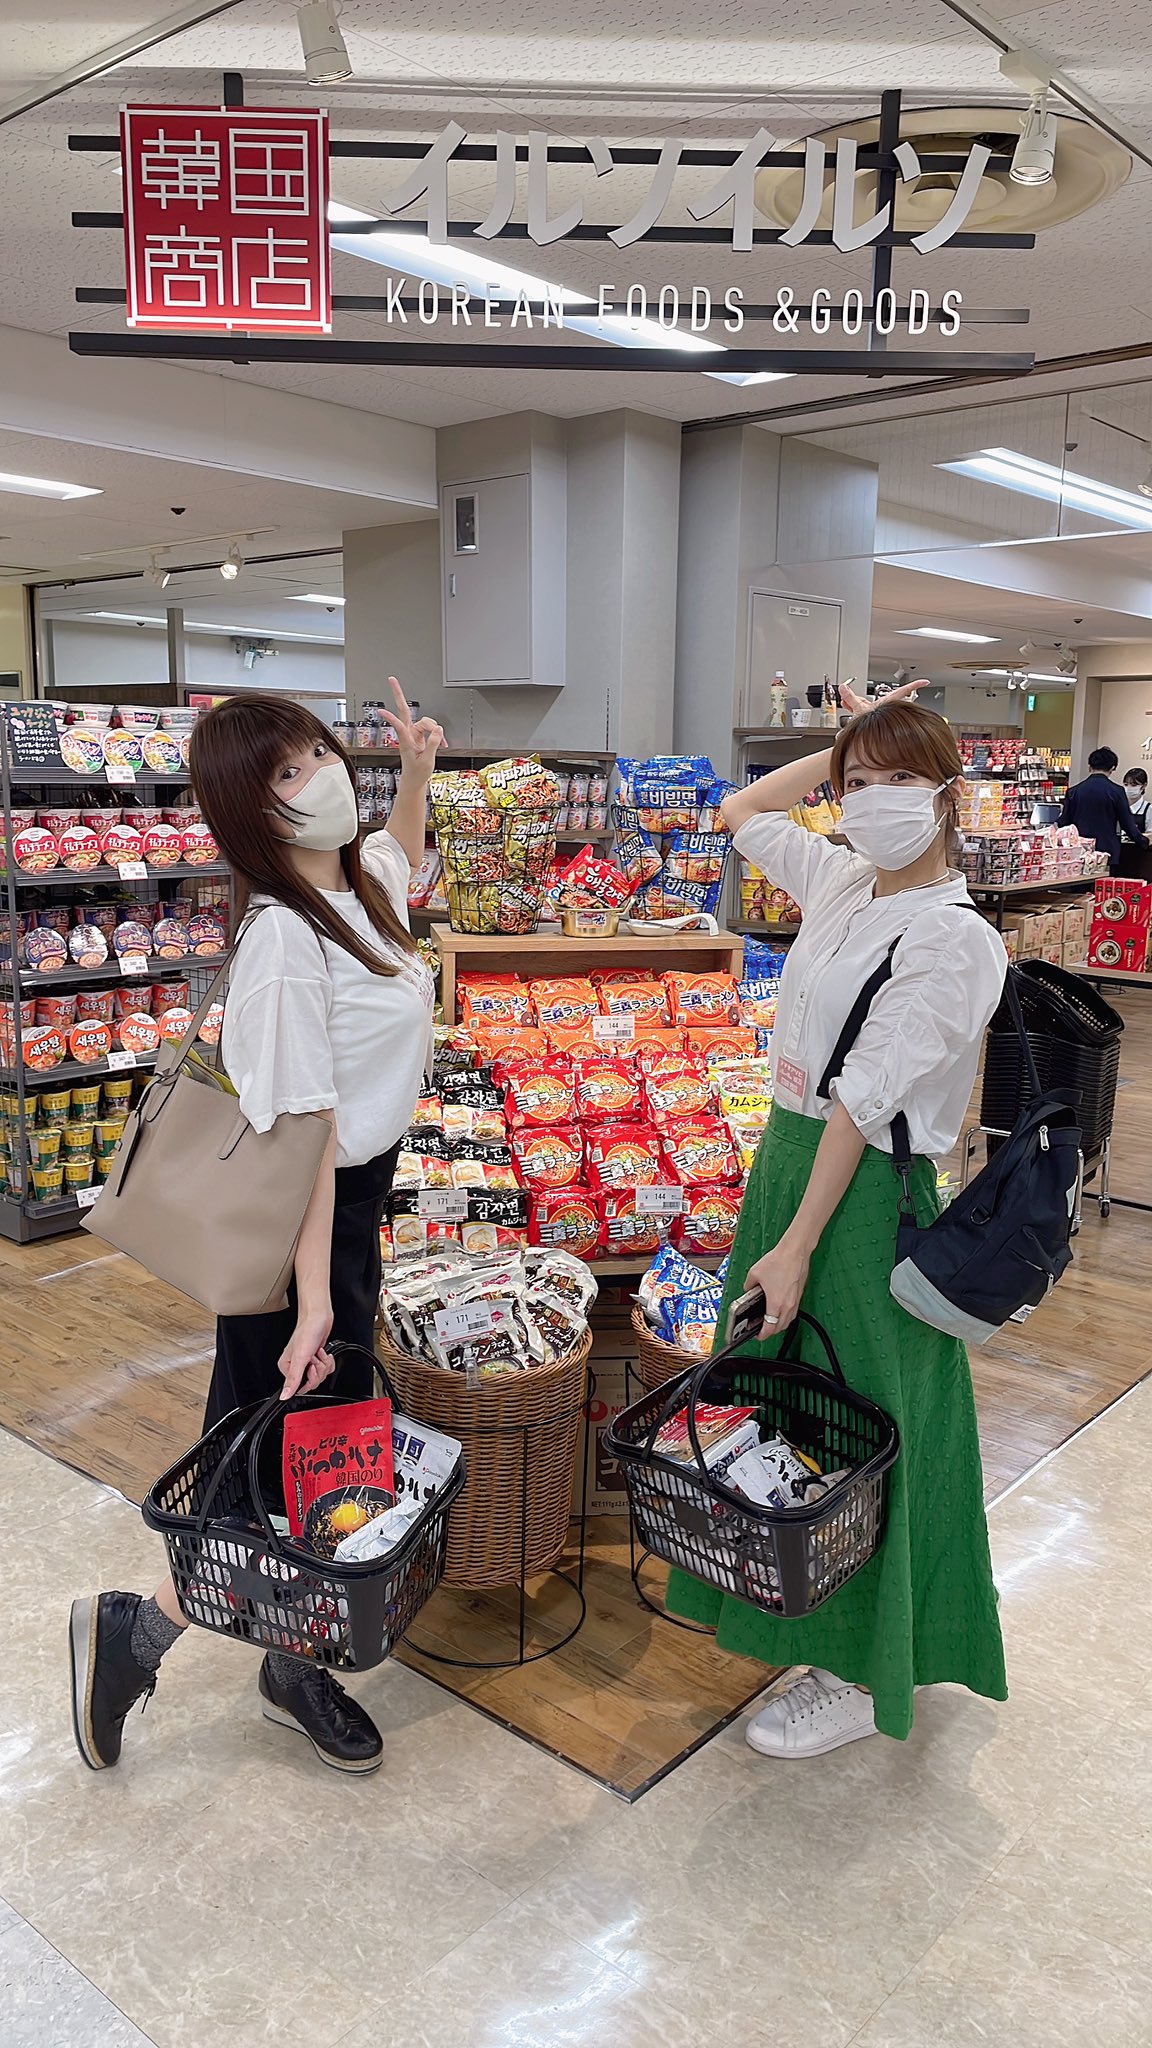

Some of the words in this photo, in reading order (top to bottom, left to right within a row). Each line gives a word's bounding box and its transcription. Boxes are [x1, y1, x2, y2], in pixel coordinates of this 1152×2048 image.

[141, 129, 310, 216] 韓国
[144, 224, 313, 311] 商店
[386, 276, 566, 329] KOREAN
[598, 282, 746, 334] FOODS
[772, 285, 965, 337] &GOODS
[489, 762, 543, 789] 짜파게티
[649, 790, 698, 807] 비빔면
[18, 840, 55, 853] キムチラーメン
[63, 839, 98, 852] キムチラーメン
[107, 837, 140, 850] キムチラーメン
[148, 837, 180, 847] キムチラーメン
[75, 1031, 107, 1047] 새우탕
[126, 1025, 156, 1042] 새우탕
[29, 1035, 60, 1058] 새우탕
[437, 1197, 448, 1205] 171
[654, 1192, 666, 1200] 144
[475, 1198, 520, 1220] 감자면
[456, 1314, 469, 1324] 171
[335, 1467, 383, 1487] 韓国のり
